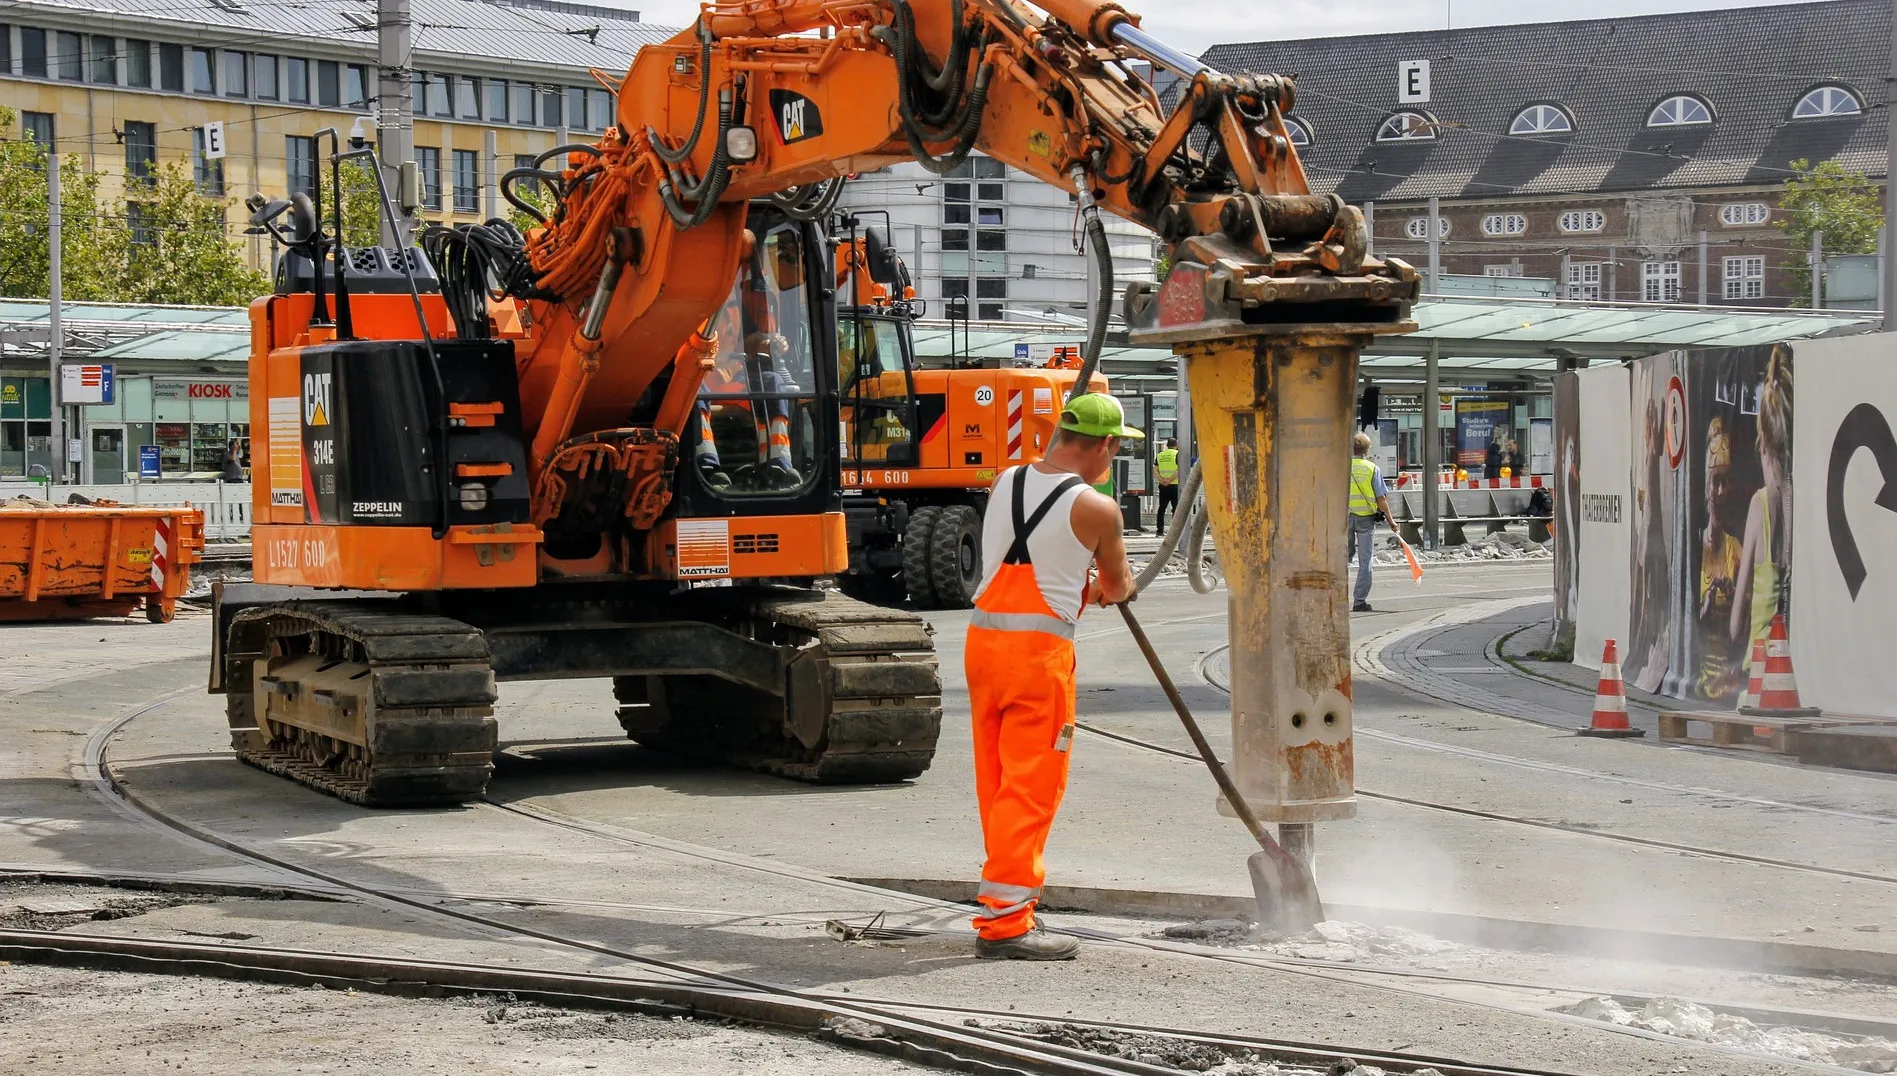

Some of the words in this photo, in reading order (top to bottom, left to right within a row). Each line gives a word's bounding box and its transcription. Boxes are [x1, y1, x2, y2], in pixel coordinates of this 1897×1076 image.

[1408, 68, 1421, 95] E
[783, 99, 805, 140] CAT
[210, 128, 219, 152] E
[103, 381, 109, 391] F
[188, 383, 232, 398] KIOSK
[977, 390, 992, 401] 20
[304, 372, 331, 426] CAT
[1465, 428, 1491, 437] Beruf
[313, 440, 333, 465] 314E
[884, 471, 909, 484] 600
[353, 502, 402, 512] ZEPPELIN
[305, 540, 325, 568] 600
